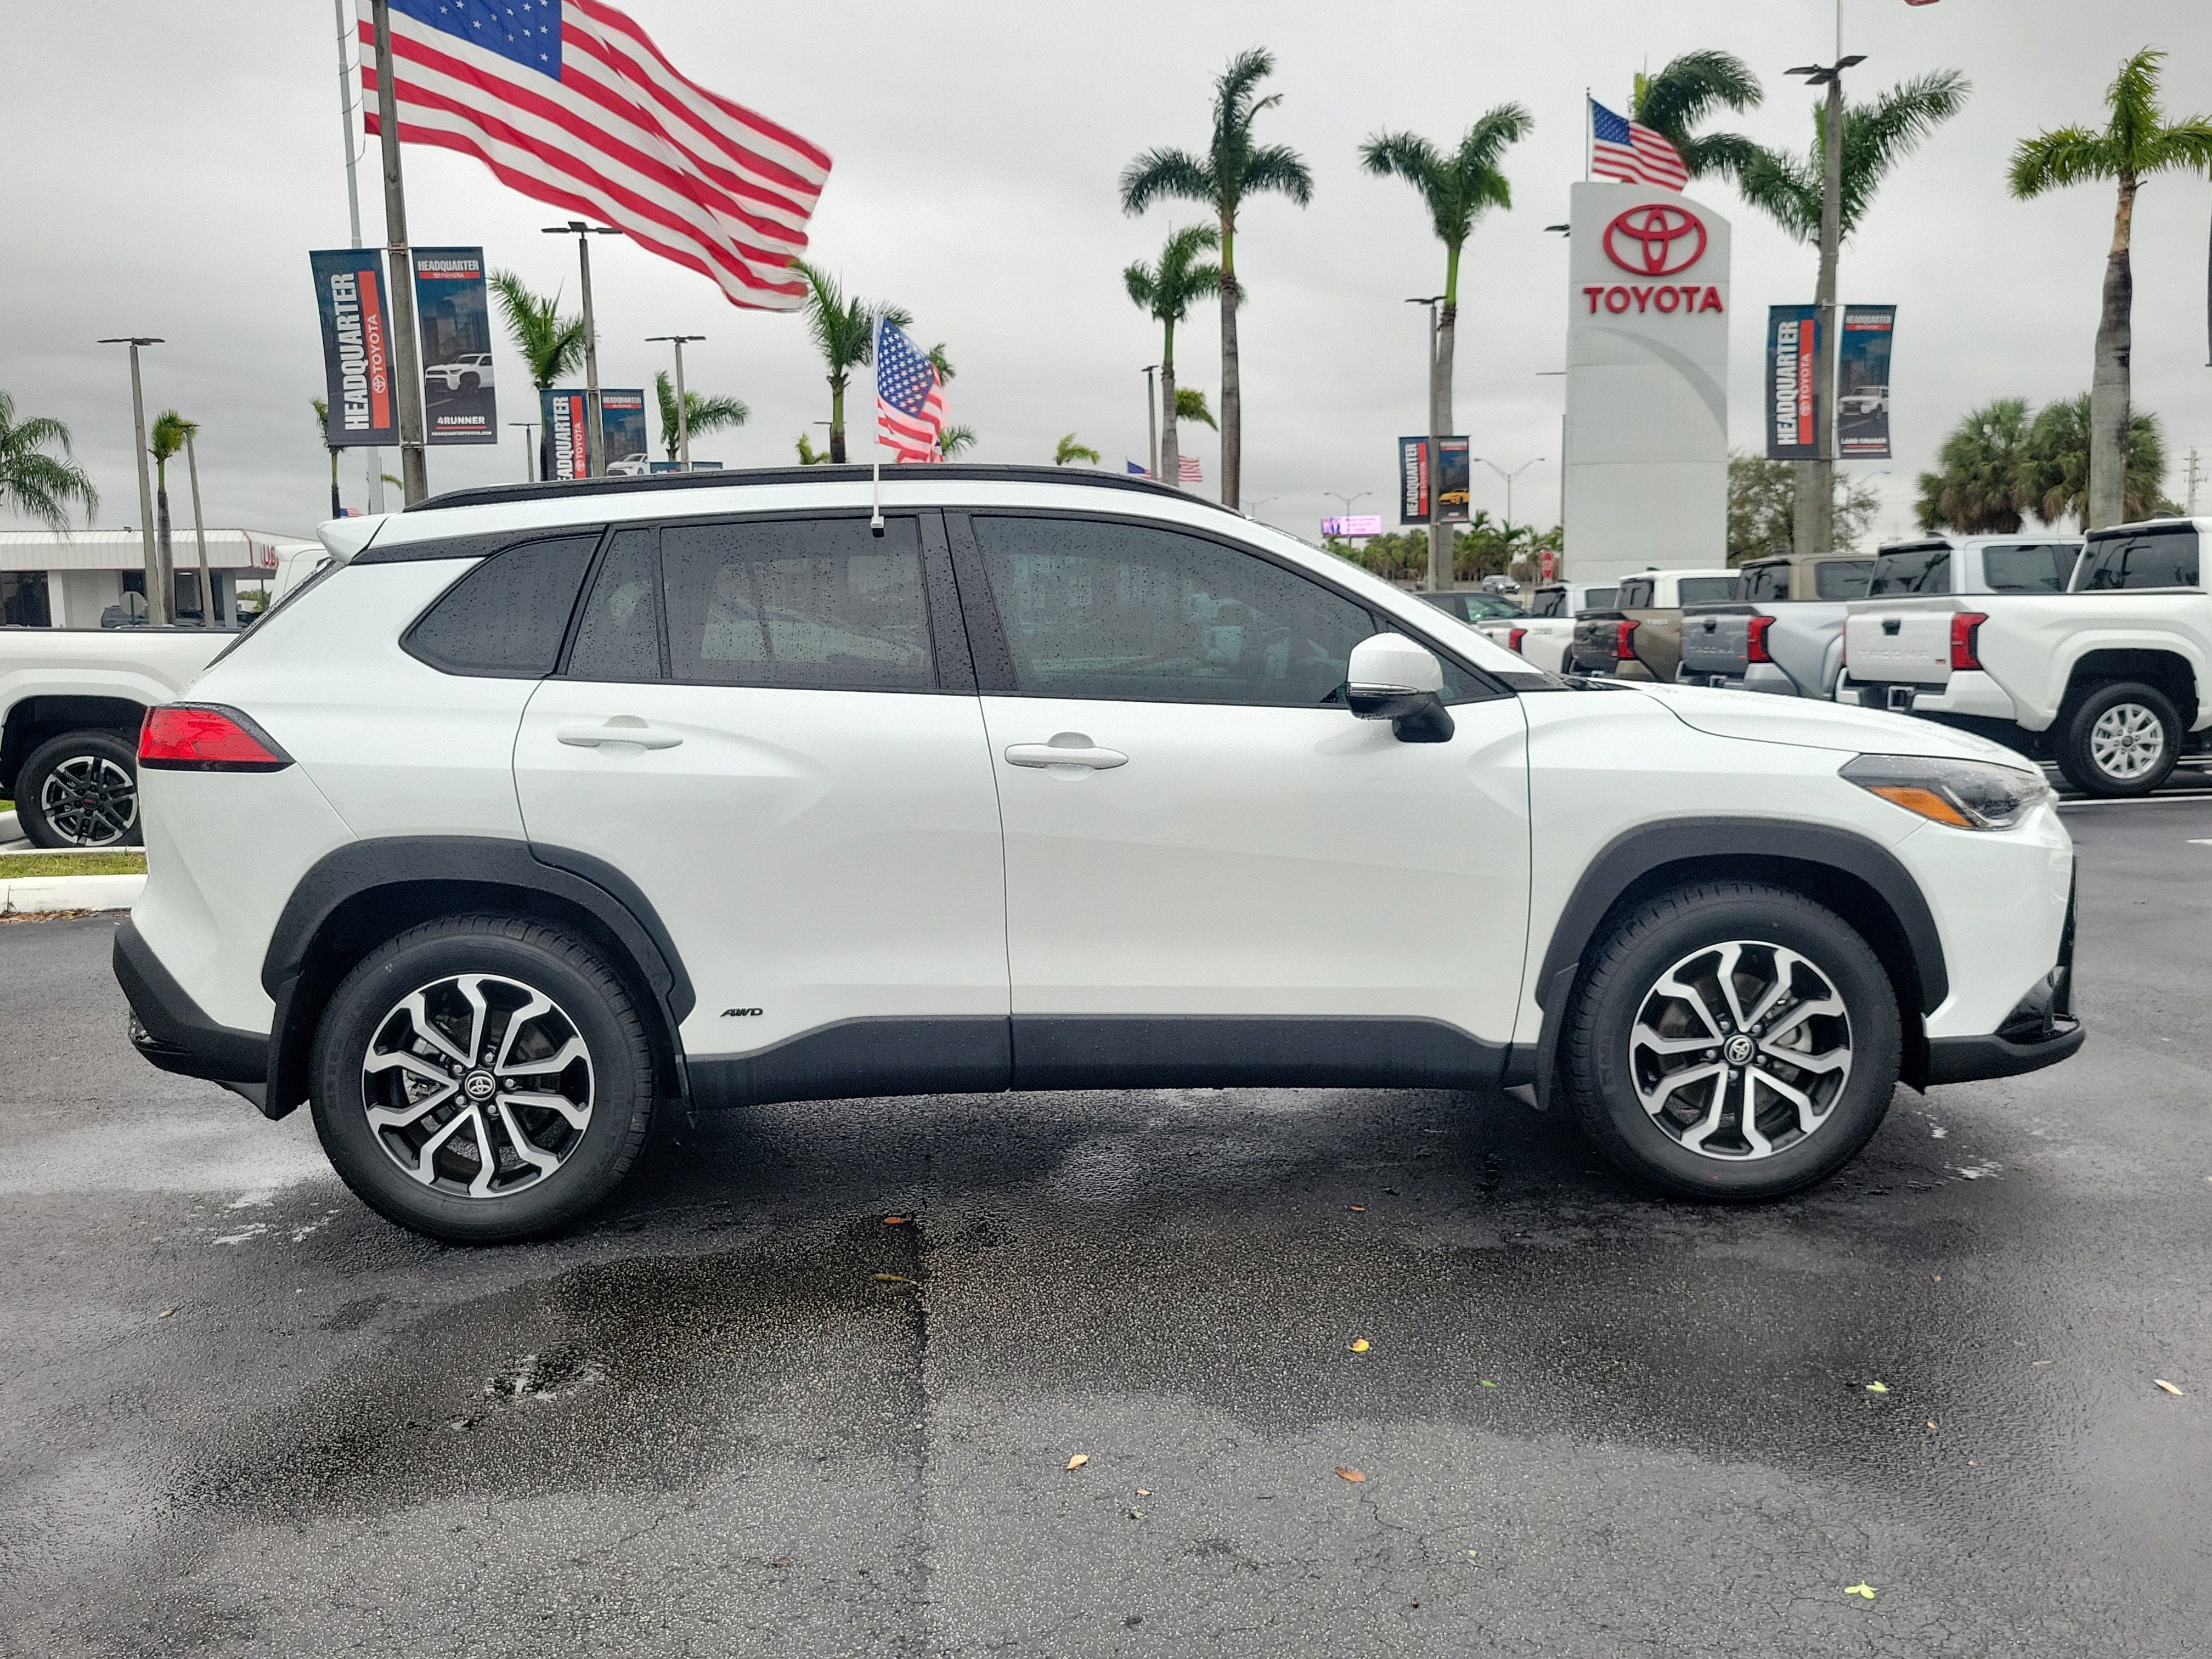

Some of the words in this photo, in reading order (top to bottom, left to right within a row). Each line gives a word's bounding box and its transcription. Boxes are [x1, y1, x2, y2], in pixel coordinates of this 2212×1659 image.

[417, 259, 479, 271] HEADQUARTER
[1583, 286, 1723, 313] TOYOTA
[330, 273, 369, 431] HEADQUARTER
[368, 314, 383, 374] TOYOTA
[1776, 320, 1799, 445] HEADQUARTER
[1800, 354, 1812, 400] TOYOTA
[437, 416, 485, 424] 4RUNNER
[574, 422, 583, 459] TOYOTA
[1406, 443, 1420, 516] HEADQUARTER
[720, 1008, 763, 1017] AWD
